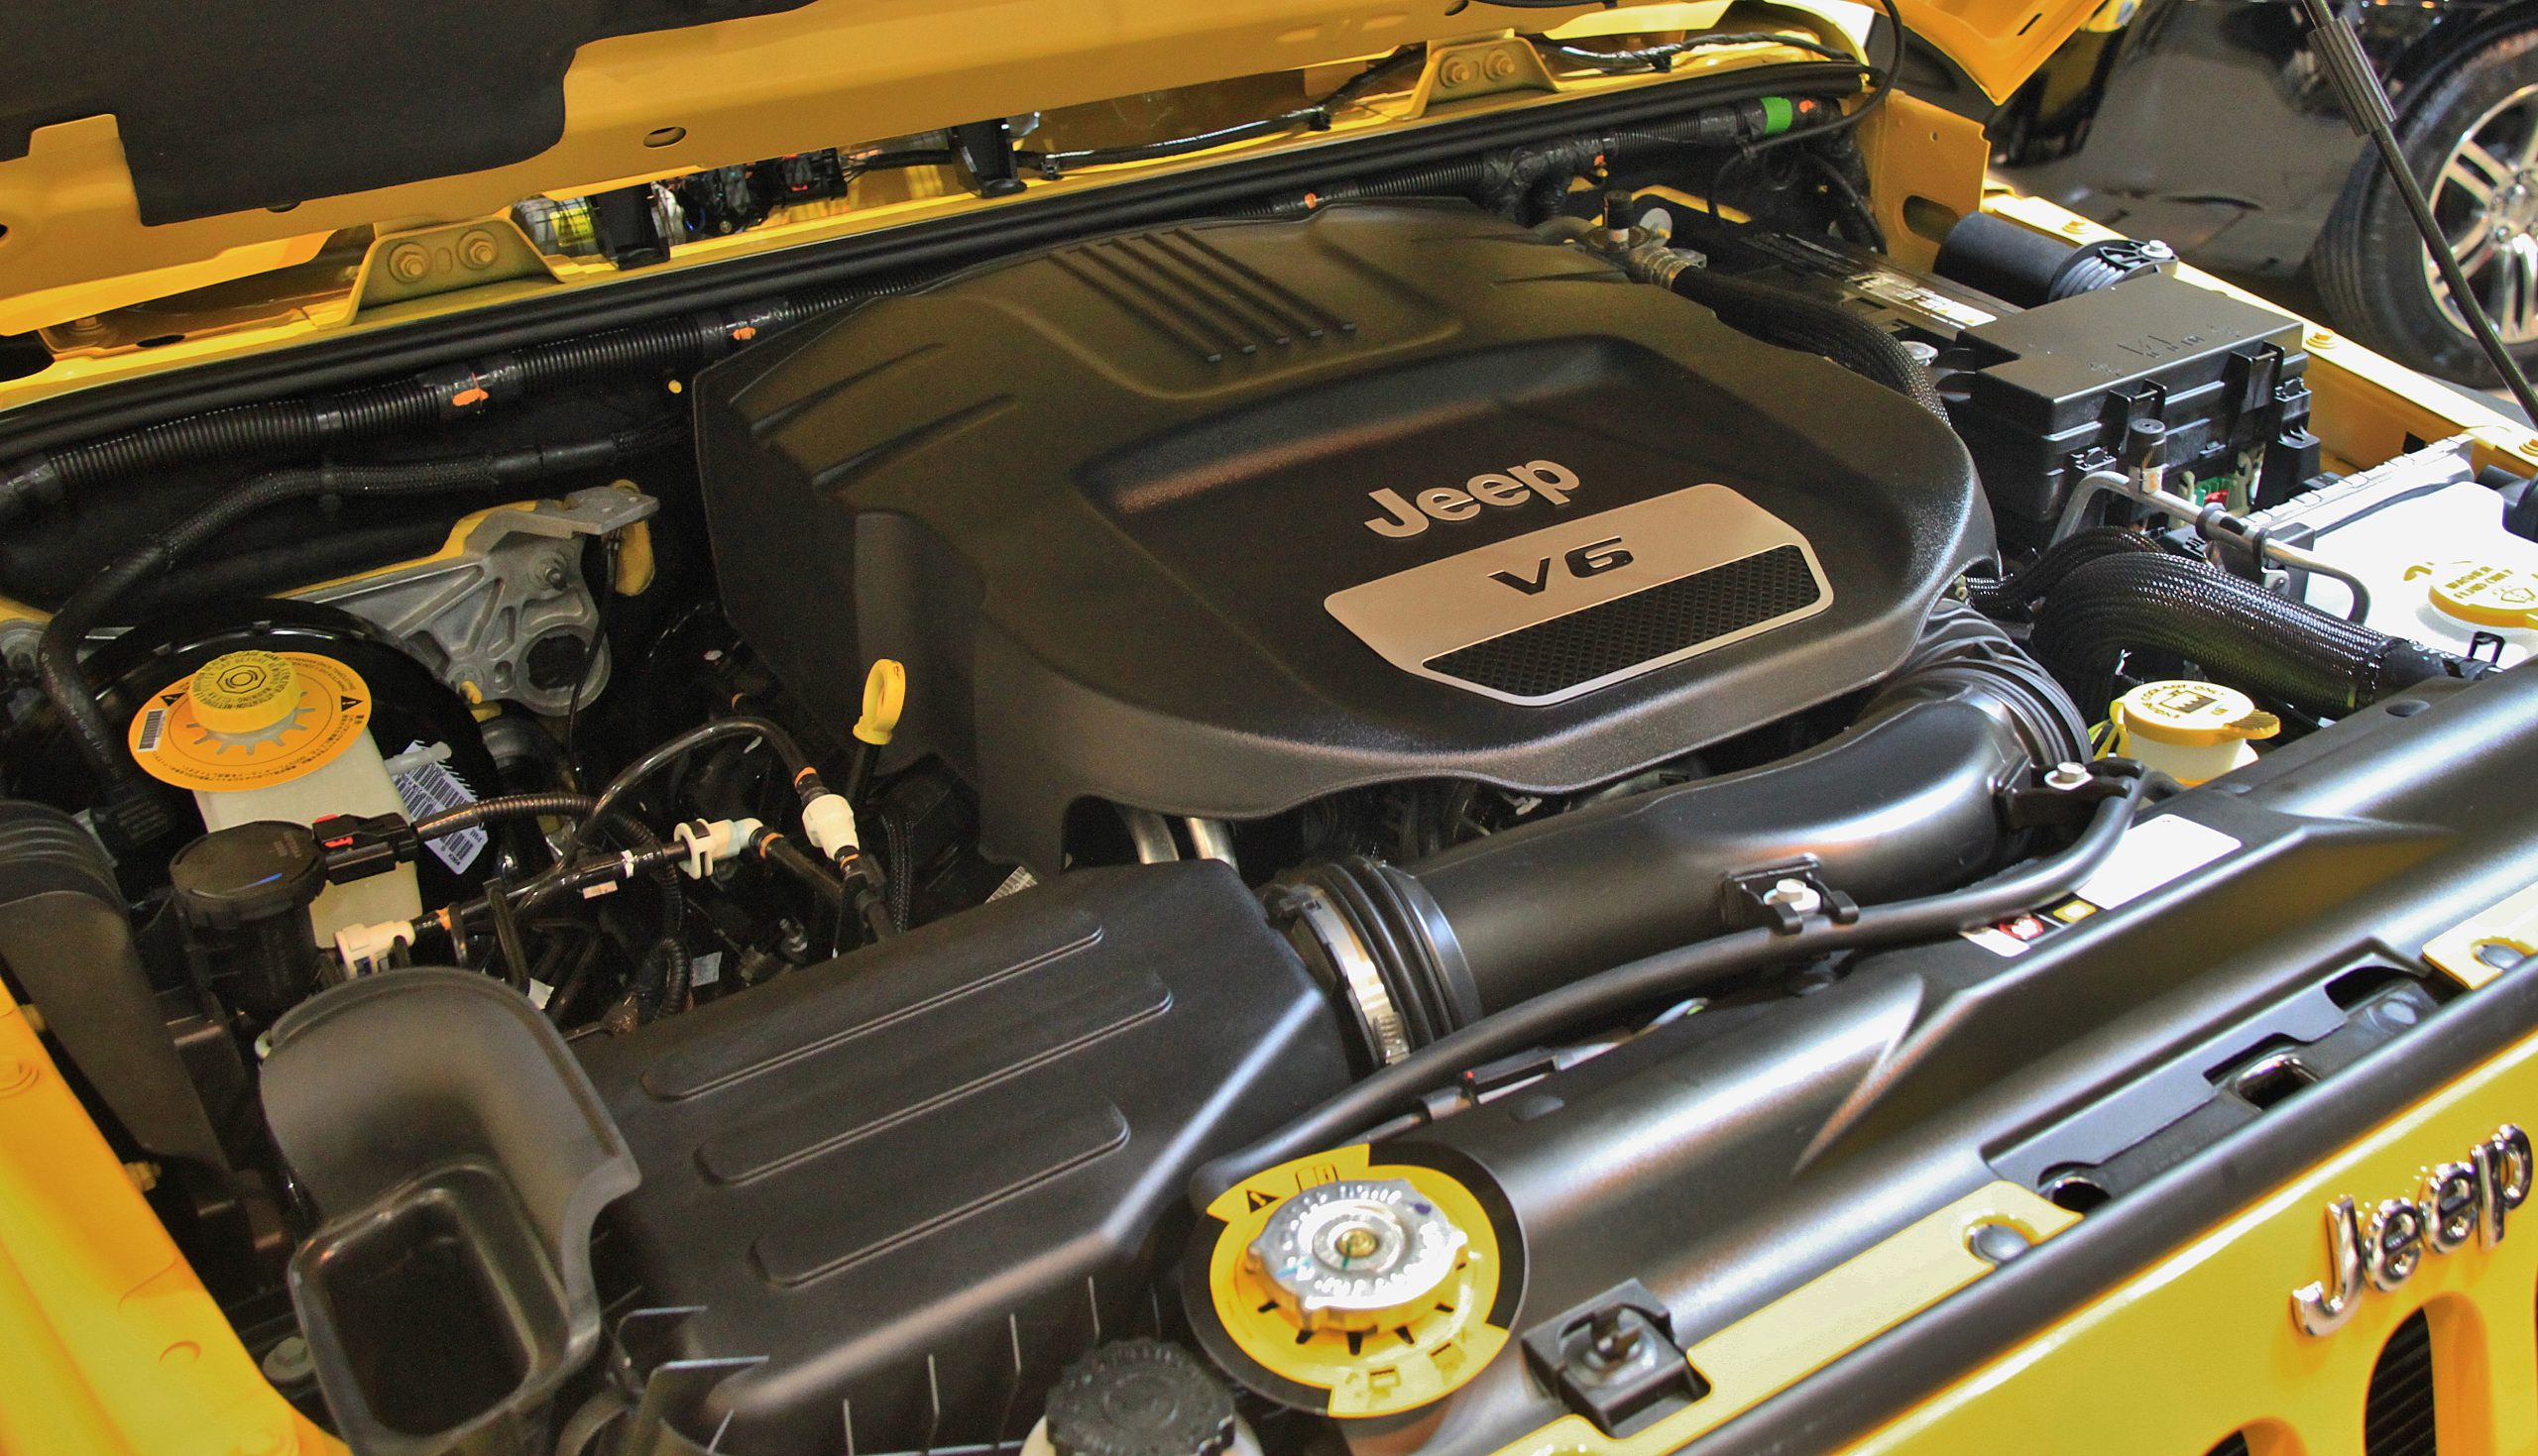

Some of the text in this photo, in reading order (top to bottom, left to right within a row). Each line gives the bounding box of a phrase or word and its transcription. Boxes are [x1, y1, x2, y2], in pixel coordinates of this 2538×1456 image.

[1364, 459, 1580, 538] Jeep
[1487, 535, 1635, 596] V6
[2445, 566, 2493, 590] WASHER
[2454, 569, 2514, 599] FLUID ONLY
[2292, 1123, 2533, 1337] Jeep
